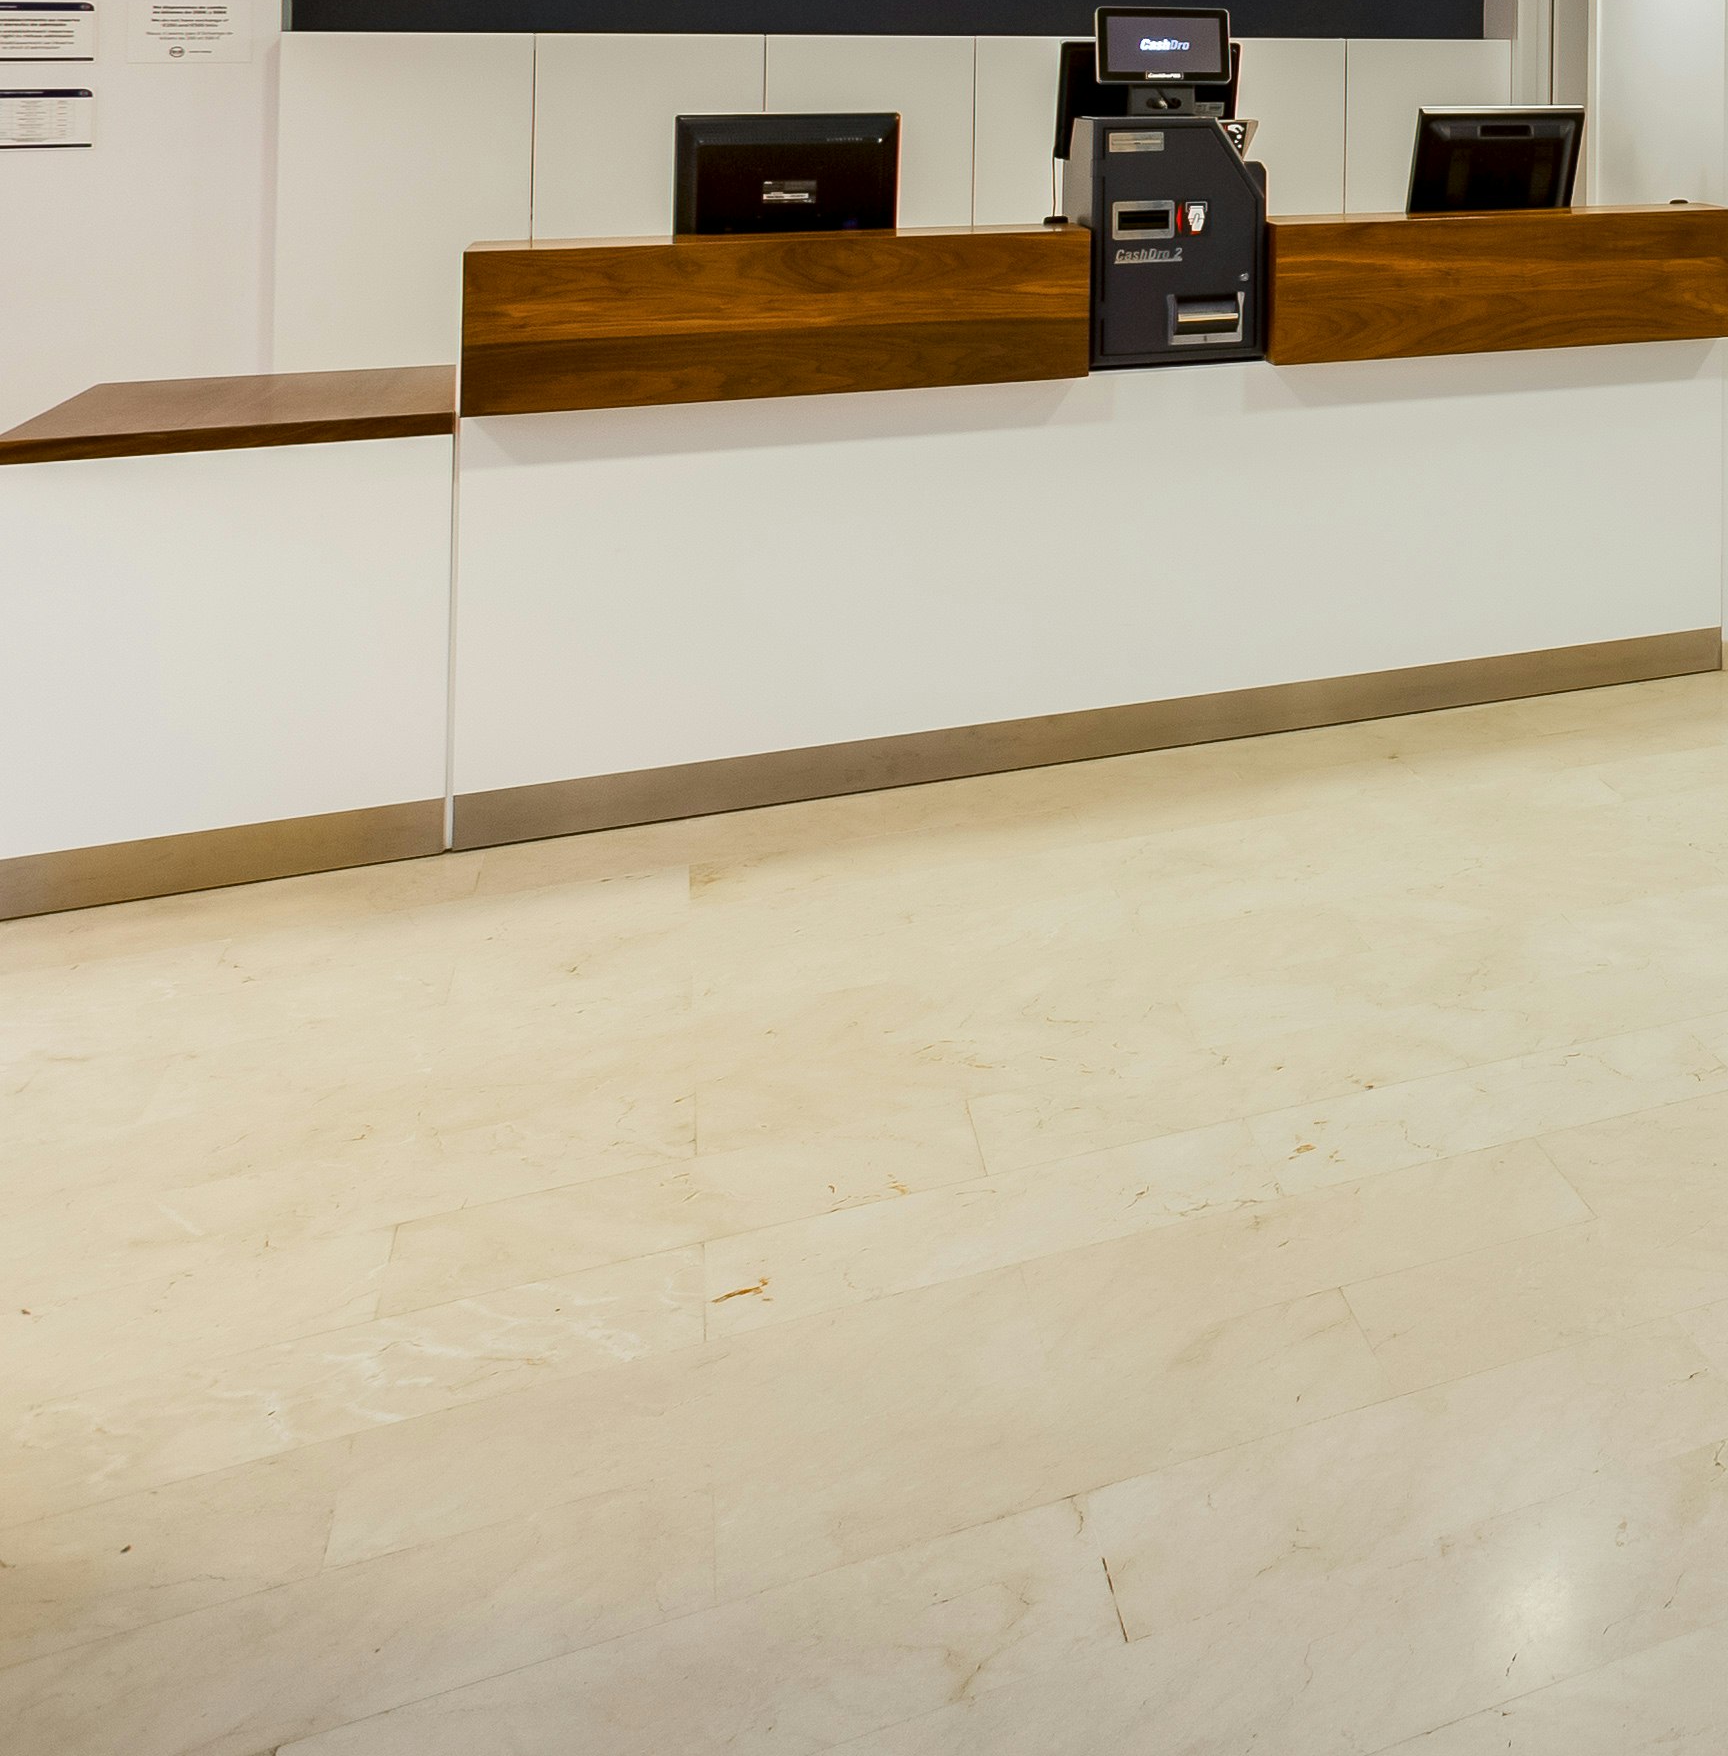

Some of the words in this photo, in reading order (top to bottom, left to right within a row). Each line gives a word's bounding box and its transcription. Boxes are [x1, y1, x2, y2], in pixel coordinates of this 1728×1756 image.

[1140, 38, 1190, 51] CashDro
[1115, 248, 1170, 262] CashDro
[1174, 247, 1183, 261] 2
